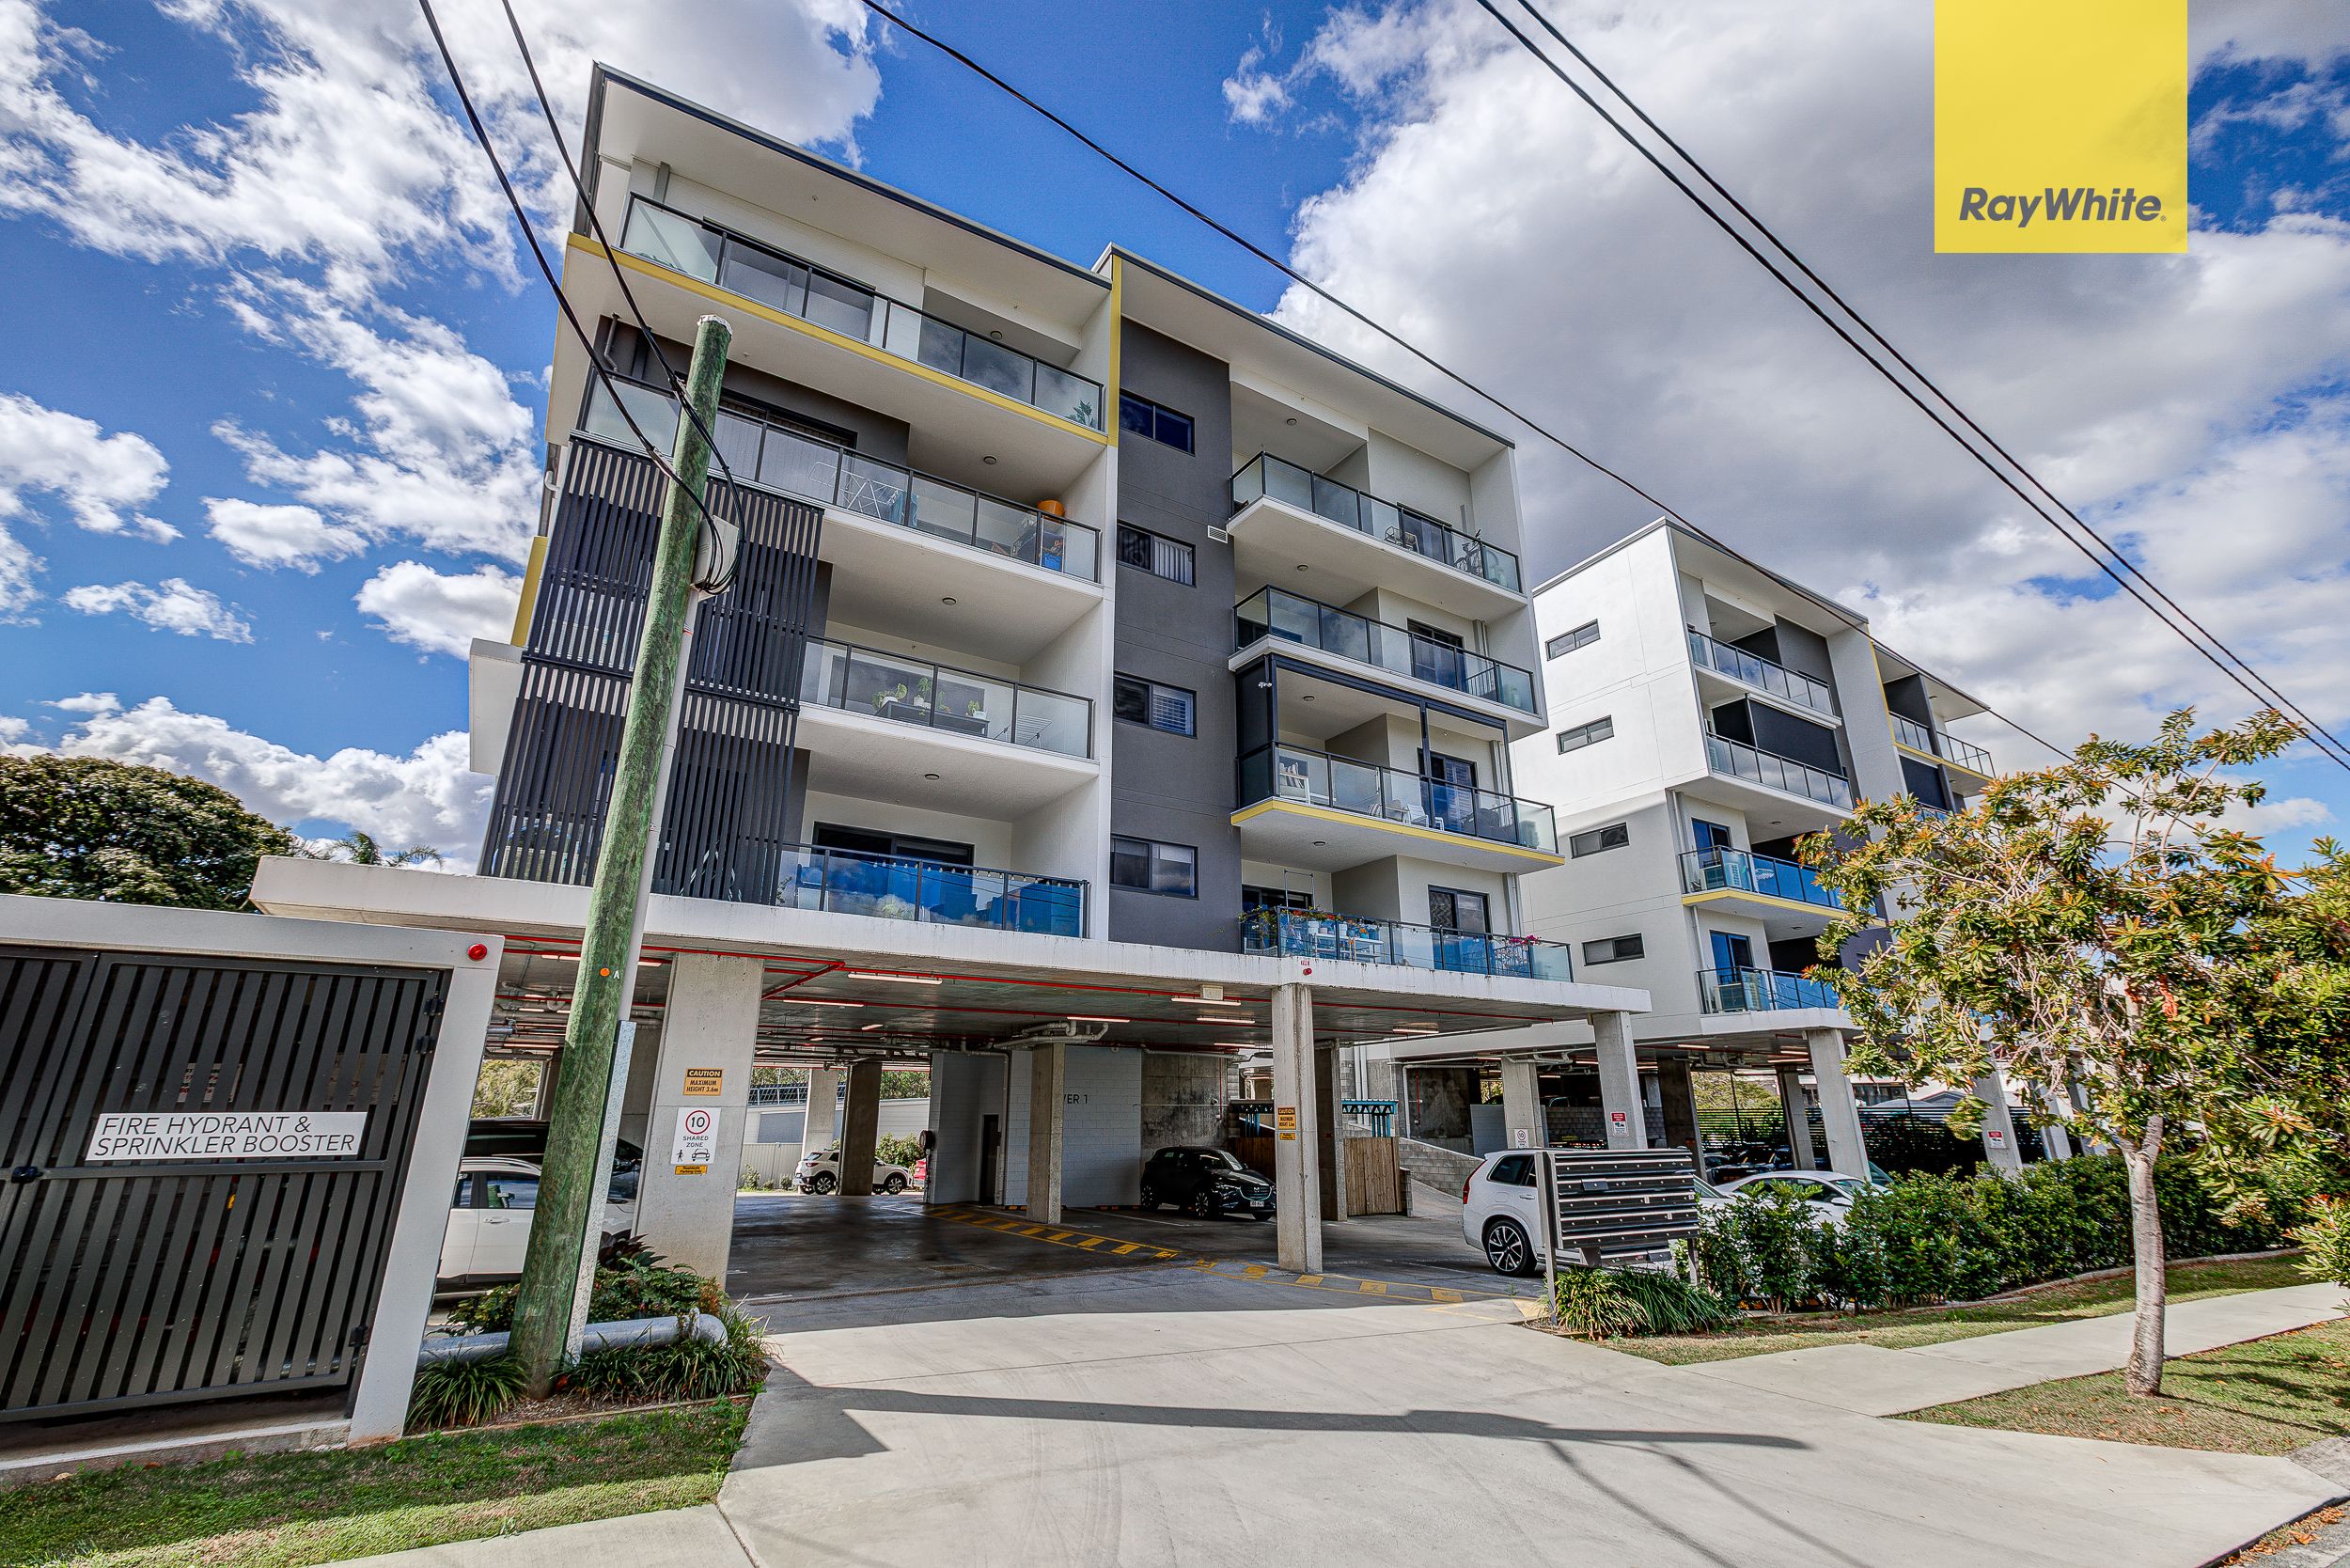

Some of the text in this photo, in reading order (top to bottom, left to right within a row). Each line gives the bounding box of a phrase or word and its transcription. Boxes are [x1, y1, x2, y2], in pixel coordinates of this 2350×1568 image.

[1083, 1094, 1089, 1105] 1
[102, 1115, 312, 1136] FIRE HYDRANT &
[691, 1116, 706, 1128] 10
[94, 1134, 355, 1156] SPRINKLER BOOSTER
